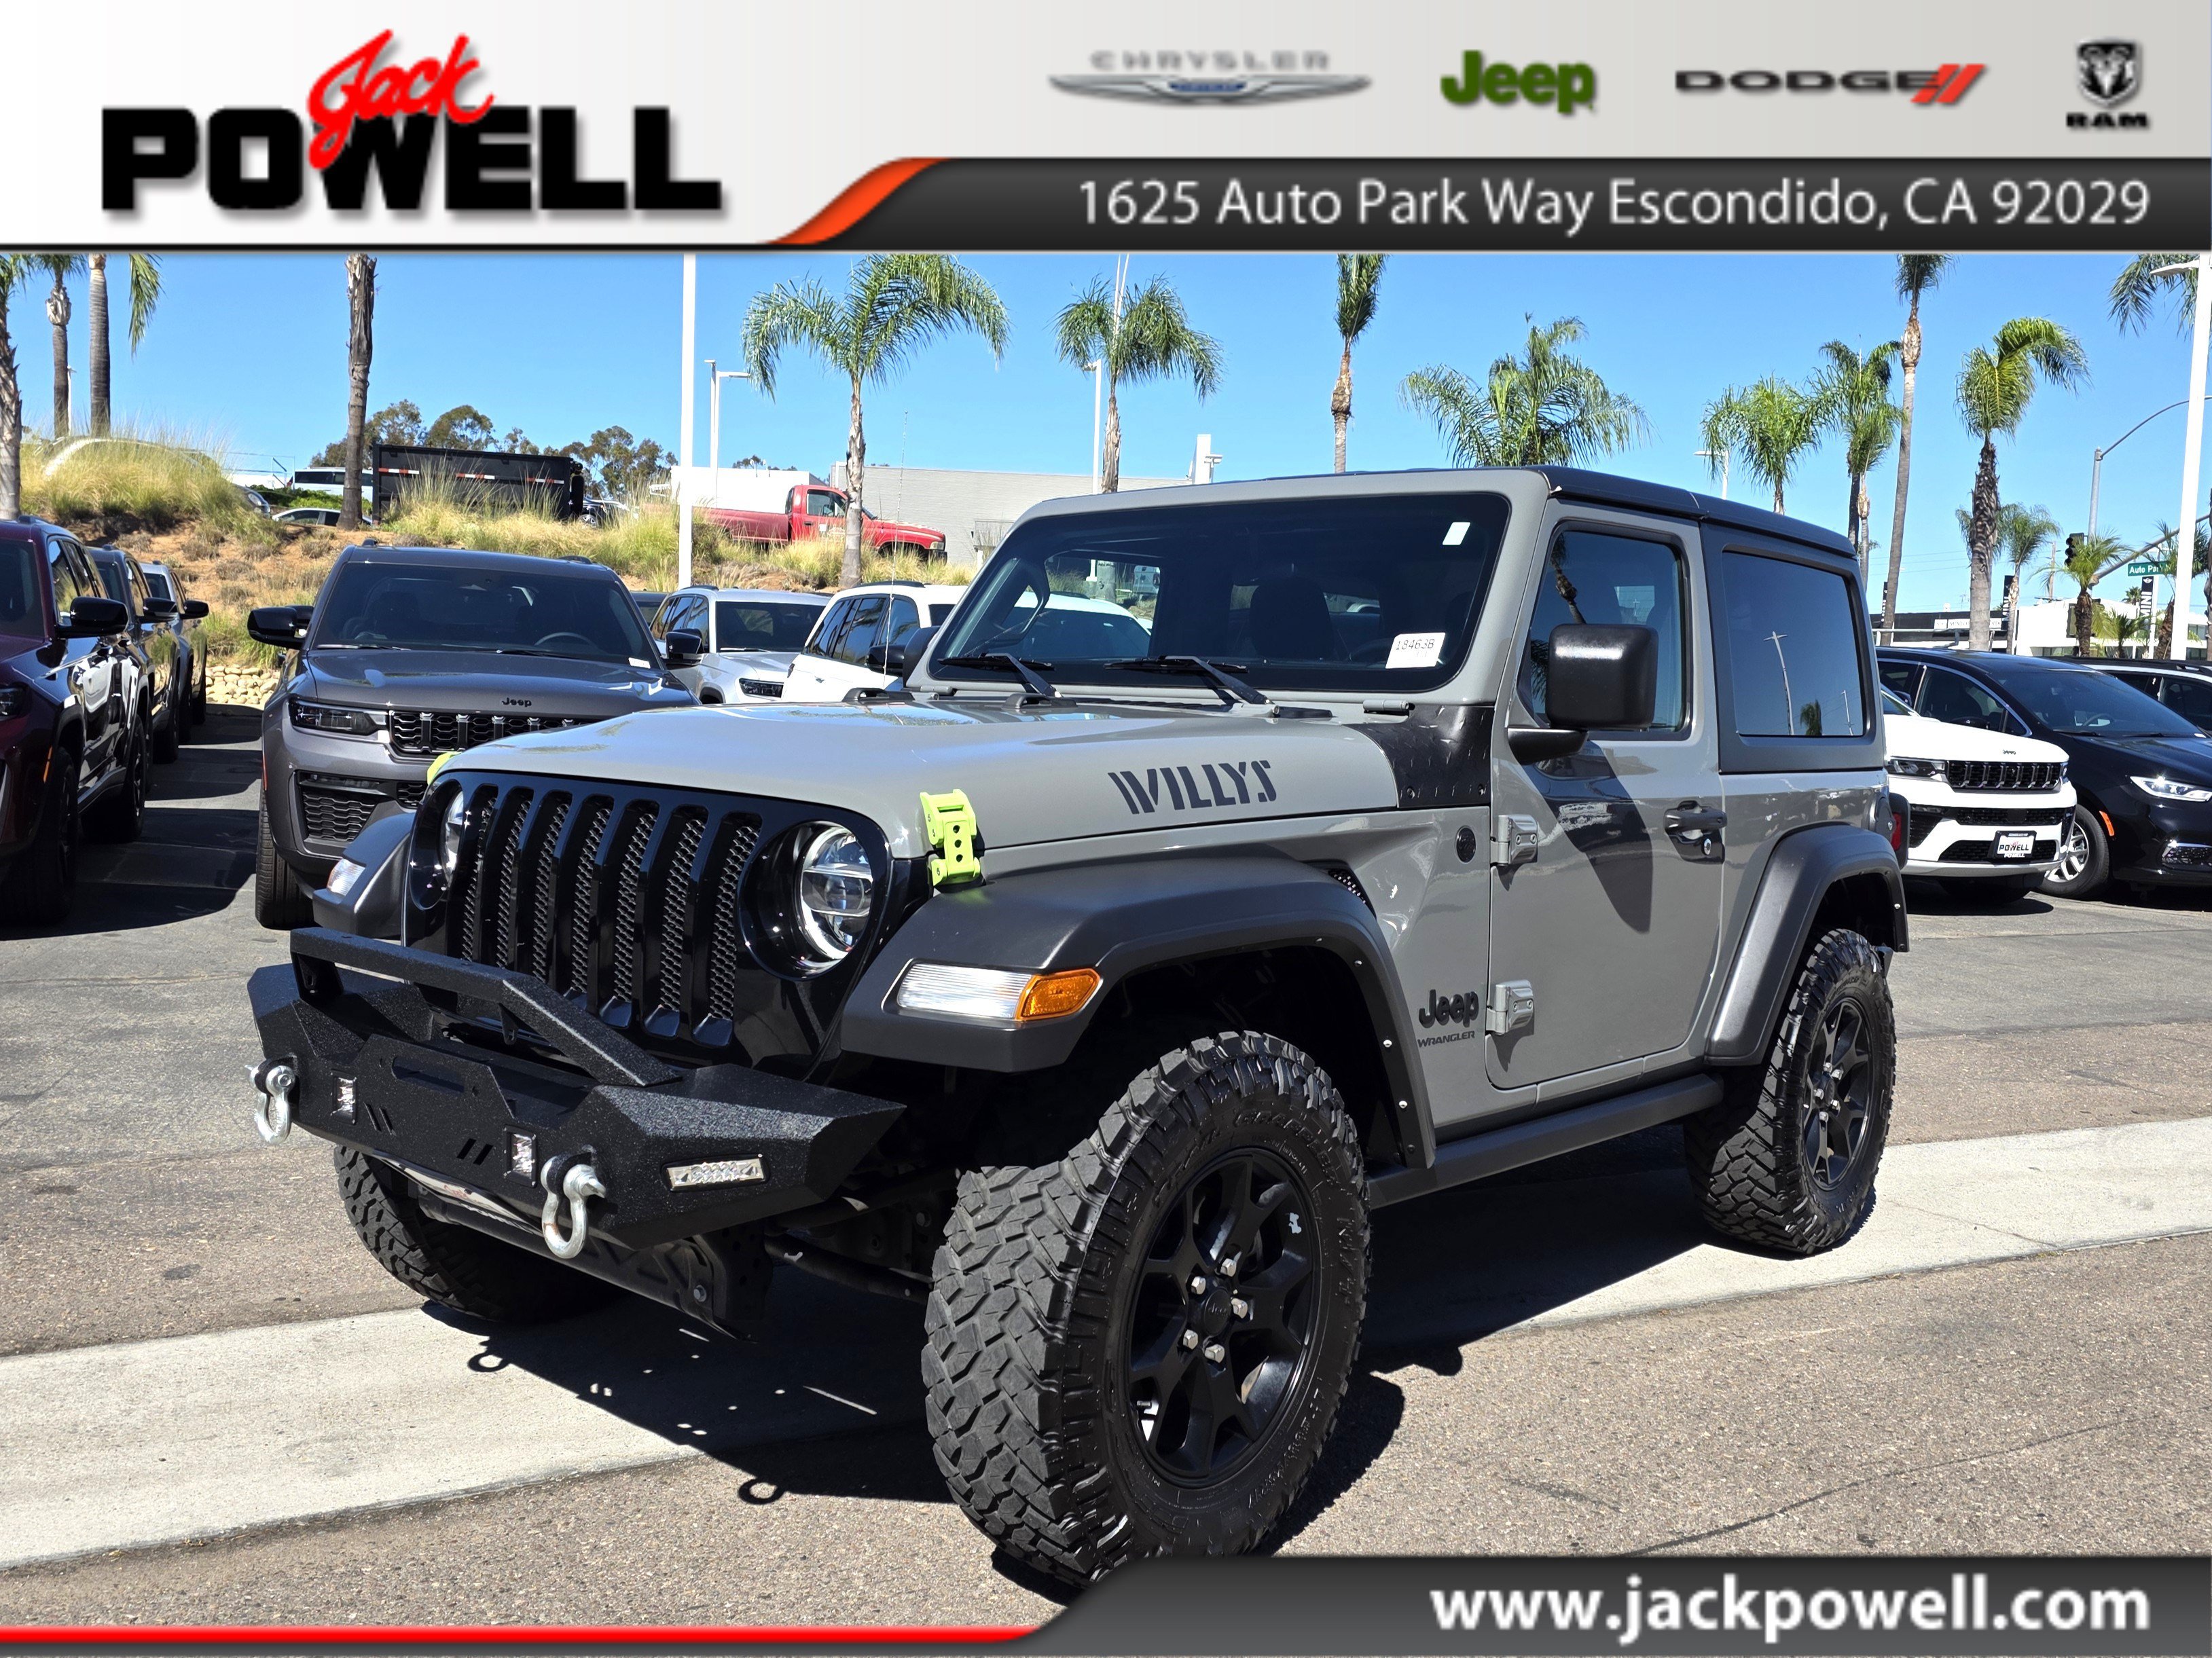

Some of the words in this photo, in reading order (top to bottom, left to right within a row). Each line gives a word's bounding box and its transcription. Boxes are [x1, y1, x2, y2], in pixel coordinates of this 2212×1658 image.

[1396, 638, 1435, 650] 18463B
[501, 697, 532, 707] Jeep
[1108, 760, 1277, 815] WILLYS
[1419, 989, 1479, 1029] Jeep
[1417, 1031, 1475, 1048] WRANGLER
